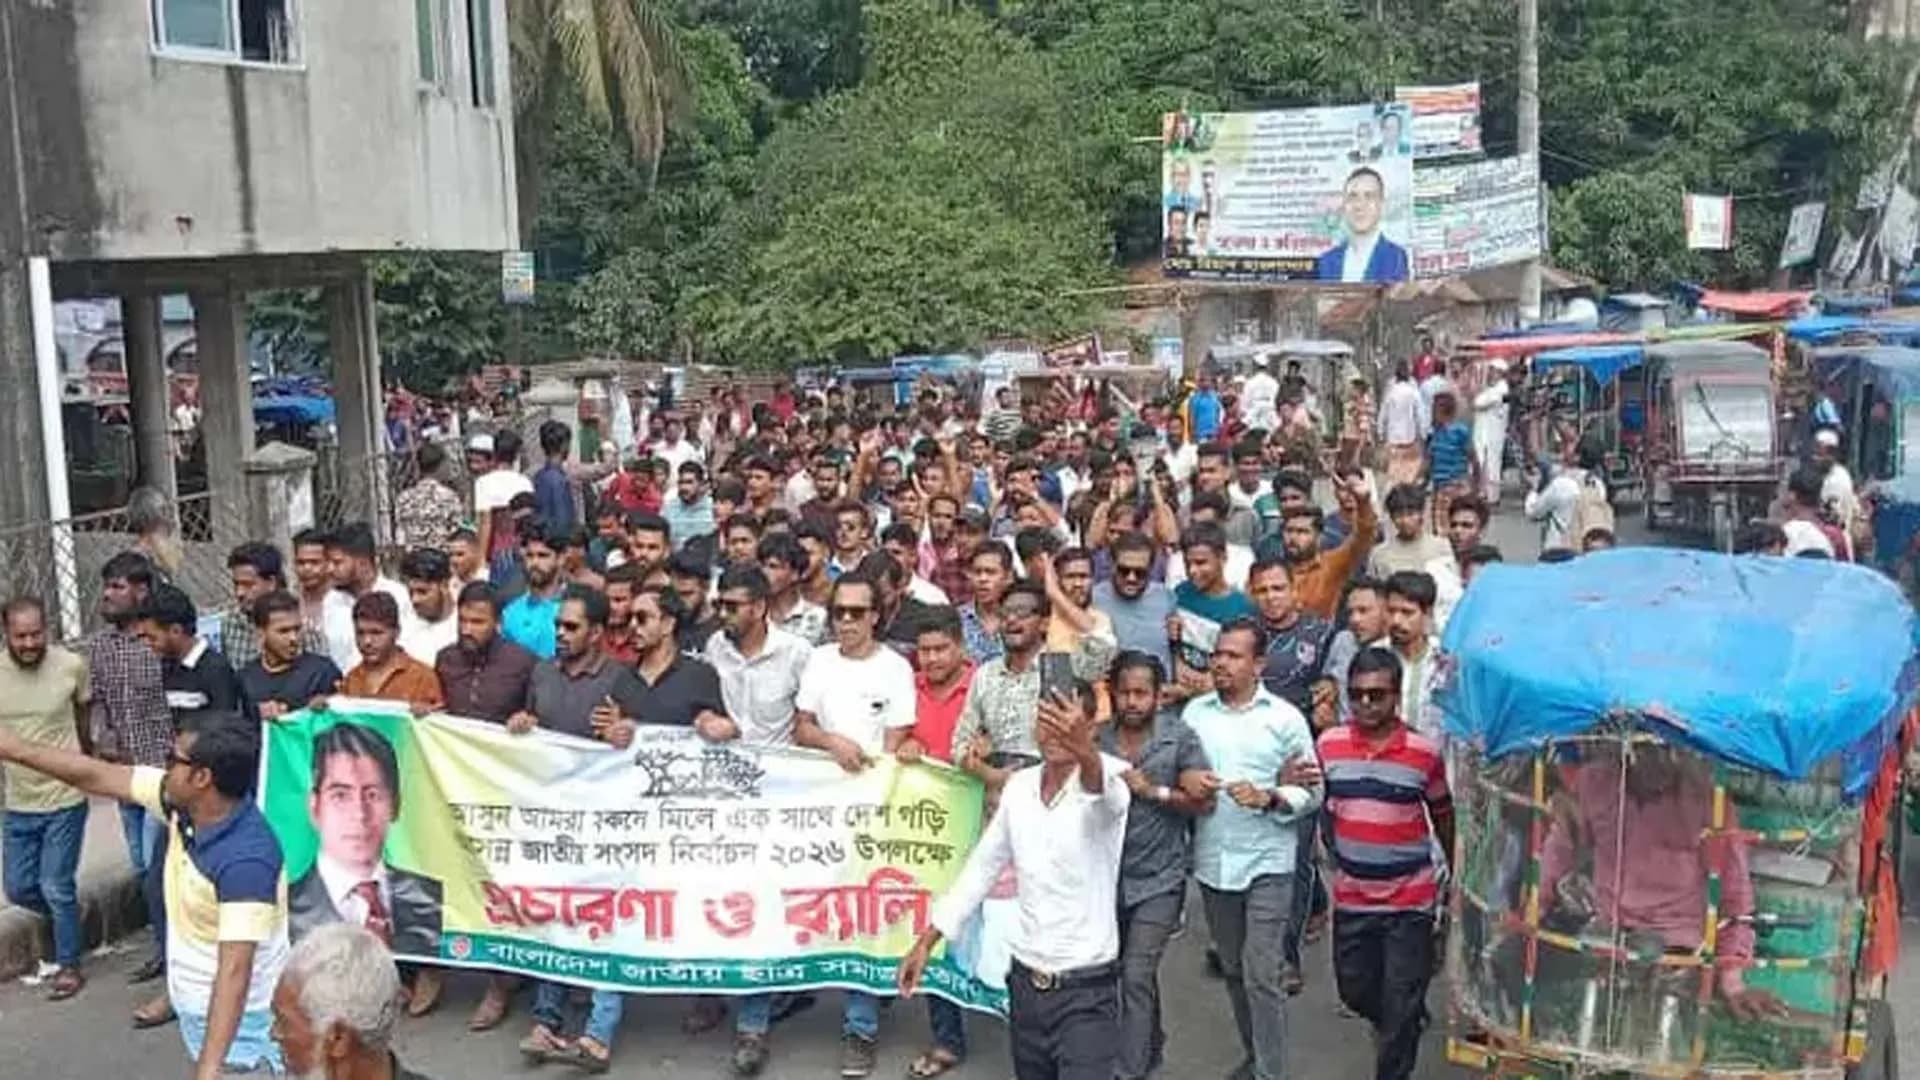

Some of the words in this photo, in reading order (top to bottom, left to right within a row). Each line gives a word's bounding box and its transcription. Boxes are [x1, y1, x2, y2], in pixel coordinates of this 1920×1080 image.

[520, 807, 585, 833] আমরা
[659, 800, 716, 831] মিলে
[726, 806, 771, 831] এক
[780, 805, 834, 830] সাথে
[844, 803, 891, 828] দেশ
[898, 798, 949, 835] গড়ি
[520, 834, 587, 865] জাতীয়
[594, 841, 660, 871] সংসদ
[669, 833, 758, 865] নির্বাচন
[769, 840, 846, 869] ২০২৬
[854, 831, 956, 866] উপলক্ষে
[703, 890, 756, 939] ও
[487, 941, 609, 977] বাংলাদেশ
[620, 960, 726, 985] জাতীয়
[739, 962, 807, 983] ছাত্র
